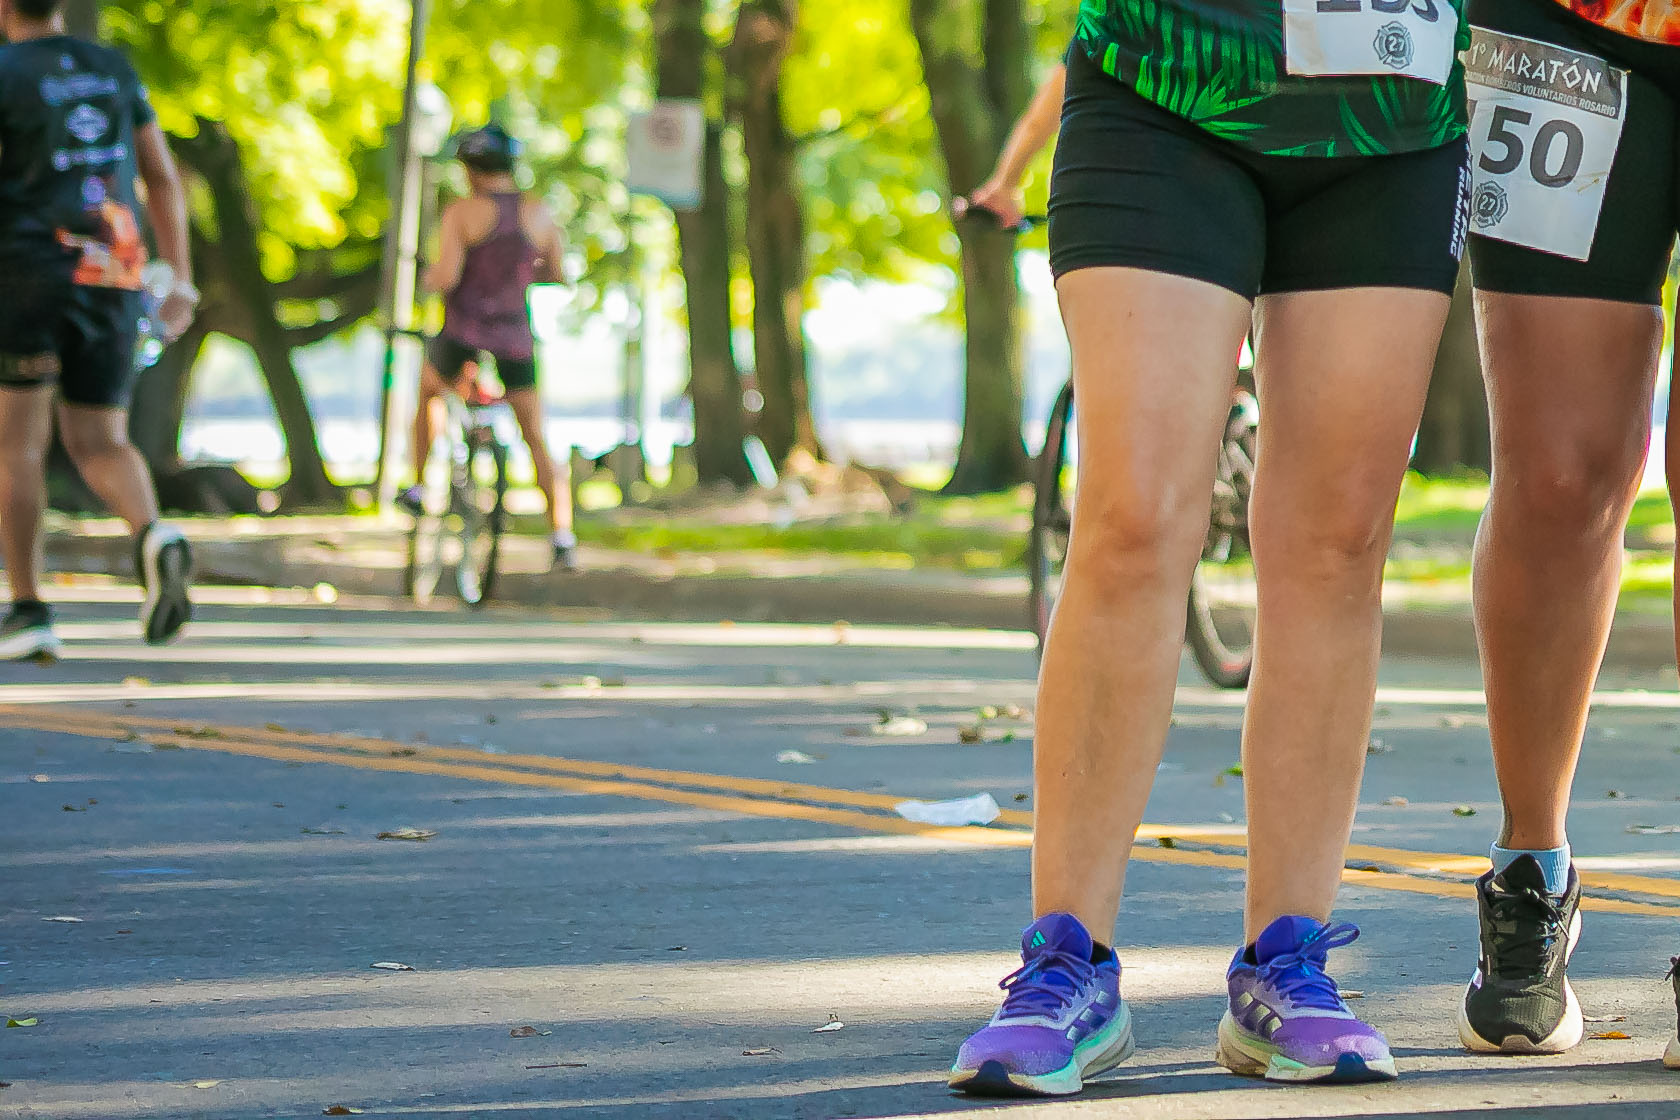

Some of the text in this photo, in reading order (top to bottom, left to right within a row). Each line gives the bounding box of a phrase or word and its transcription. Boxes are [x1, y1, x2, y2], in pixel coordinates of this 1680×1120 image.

[1487, 46, 1602, 94] MARATÓN
[1522, 84, 1578, 107] VOLUNTARIOS
[1578, 97, 1617, 117] ROSARIO
